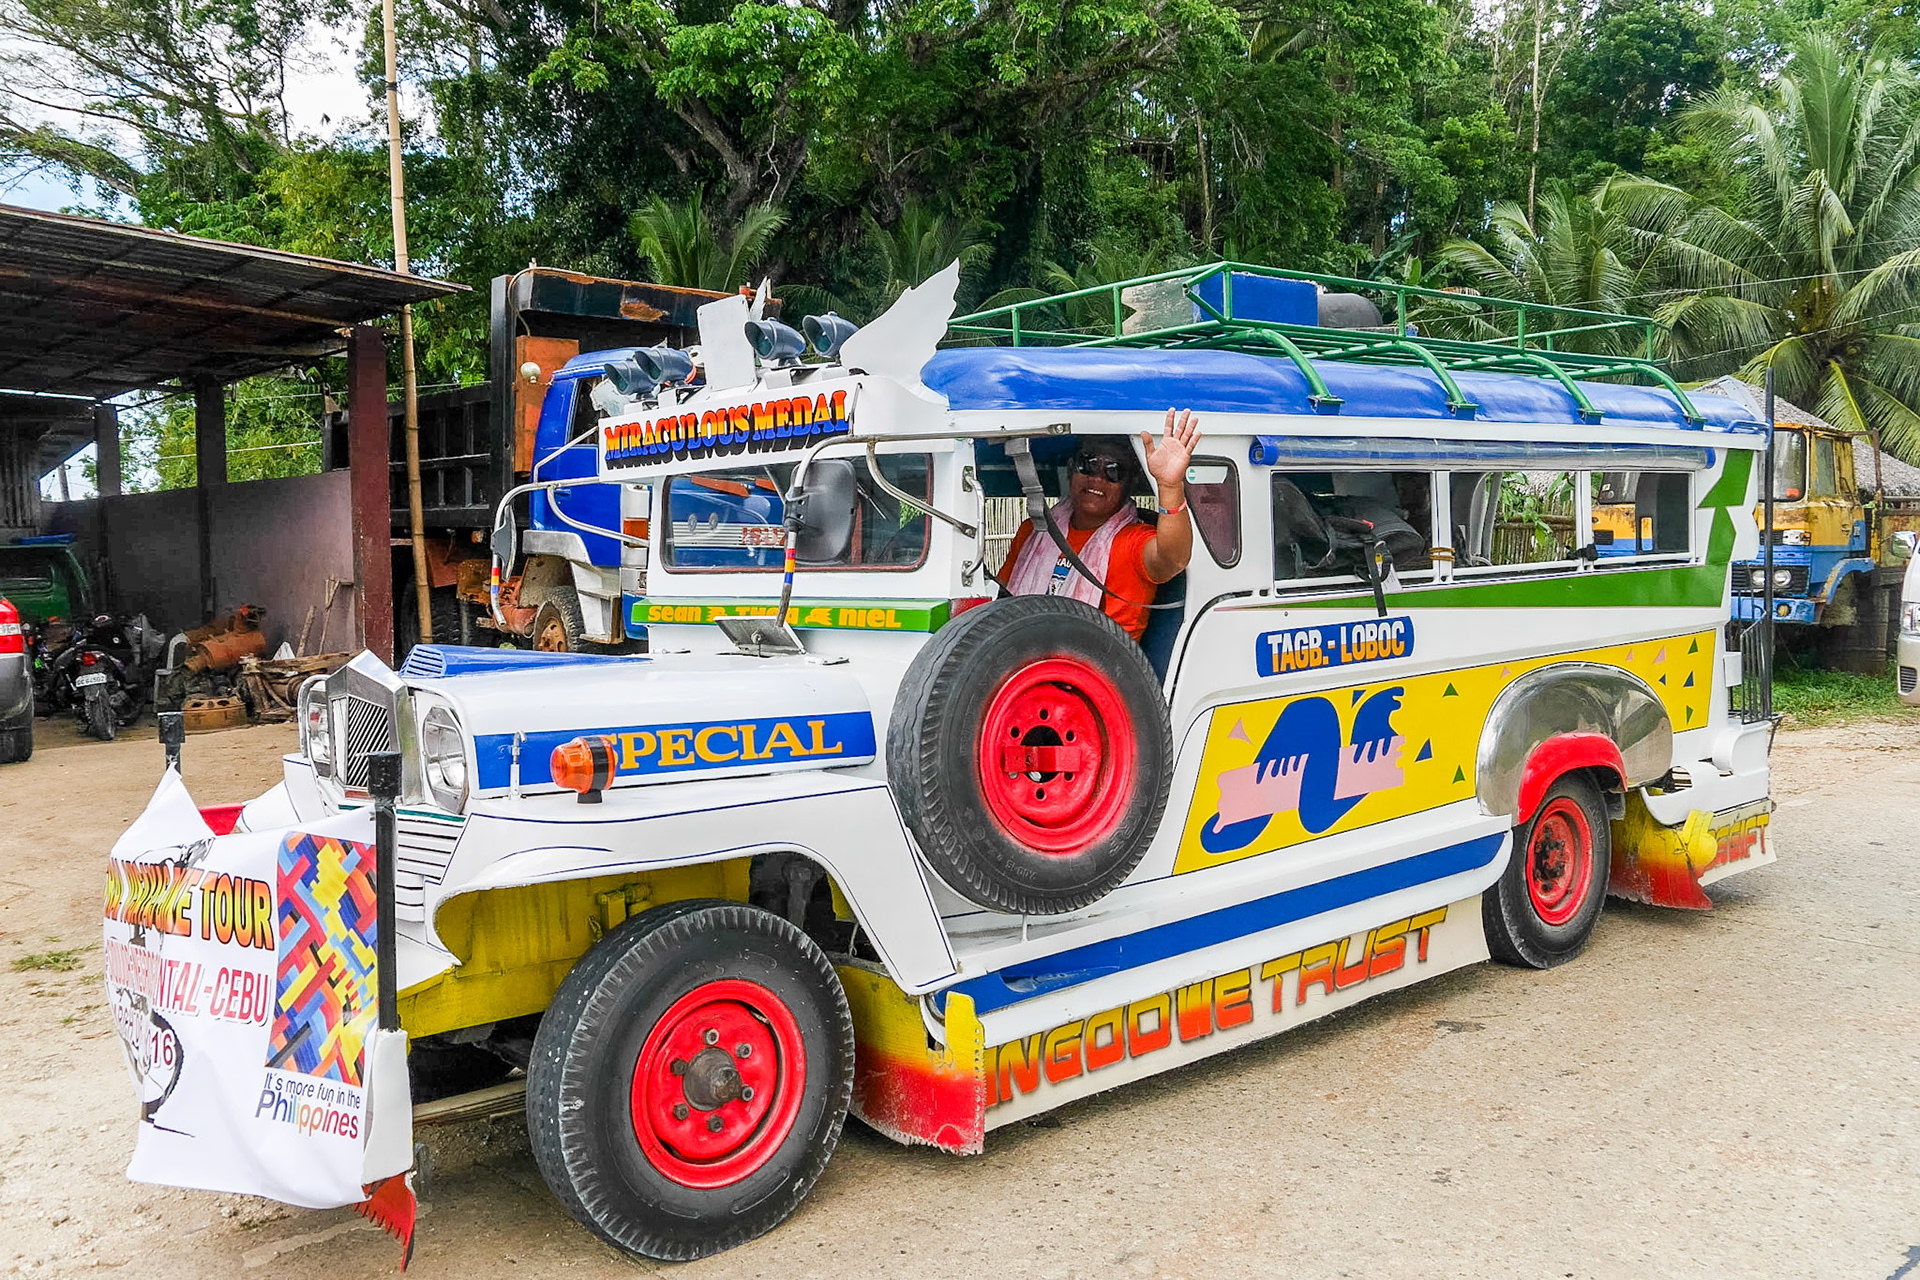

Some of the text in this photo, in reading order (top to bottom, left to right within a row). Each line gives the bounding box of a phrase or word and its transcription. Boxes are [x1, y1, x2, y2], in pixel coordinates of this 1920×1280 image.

[604, 389, 851, 463] MIRACULOUS MEDAL
[1340, 620, 1406, 663] LOBOC
[200, 870, 275, 951] TOUR
[1176, 967, 1254, 1043] WE
[1260, 906, 1449, 1014] TRUST
[254, 1089, 359, 1140] Philippines
[263, 1072, 361, 1110] It's more fun in the
